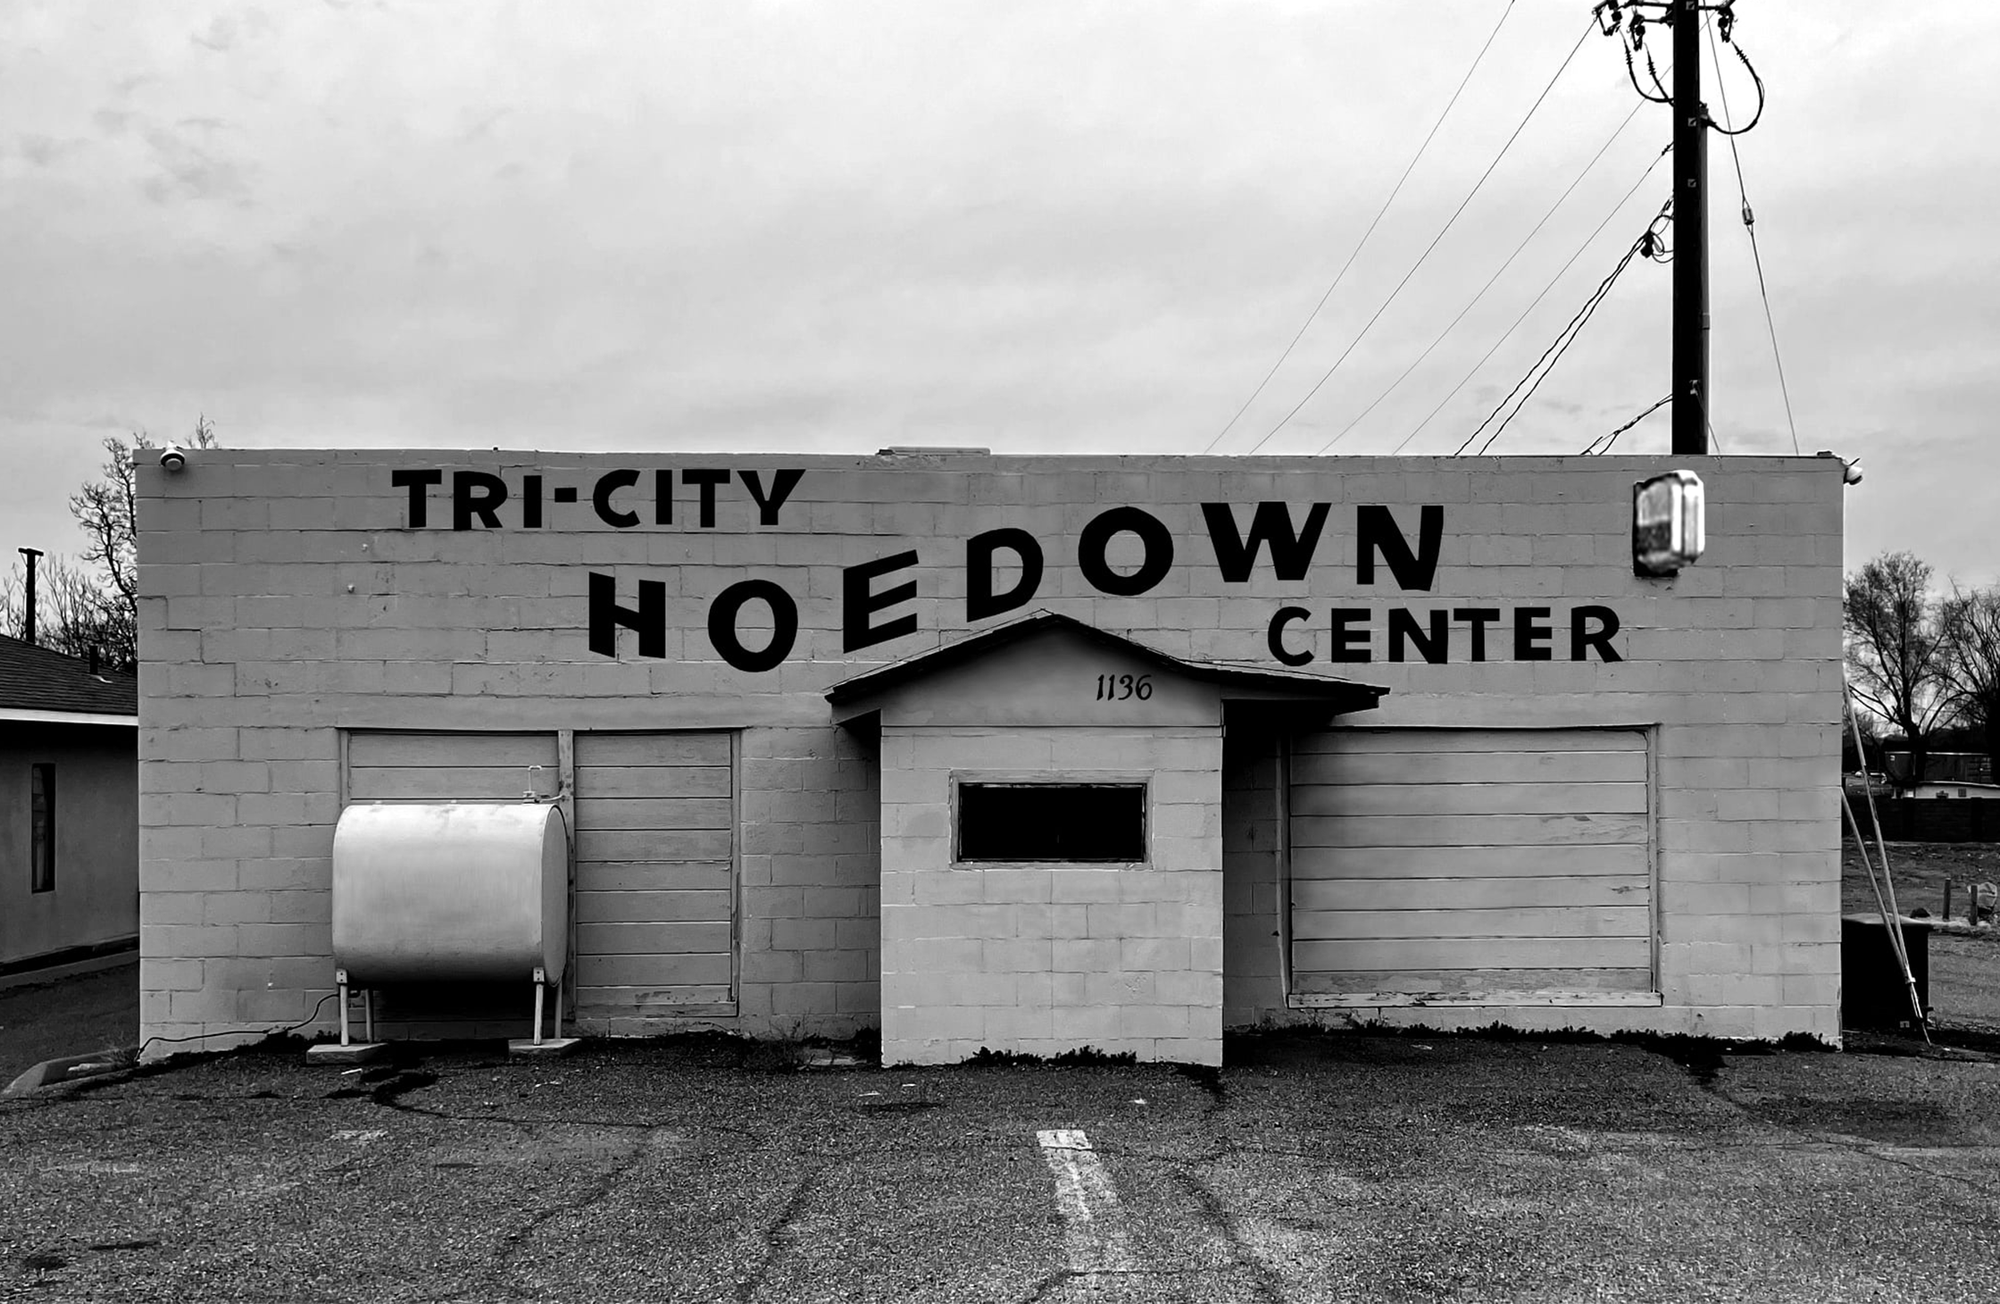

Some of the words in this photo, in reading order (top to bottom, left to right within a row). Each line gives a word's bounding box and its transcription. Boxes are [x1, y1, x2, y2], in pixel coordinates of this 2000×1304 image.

[392, 468, 805, 531] TRI-CITY
[589, 502, 1443, 672] HOEDOWN
[1268, 606, 1623, 666] CENTER
[1096, 674, 1153, 701] 1136
